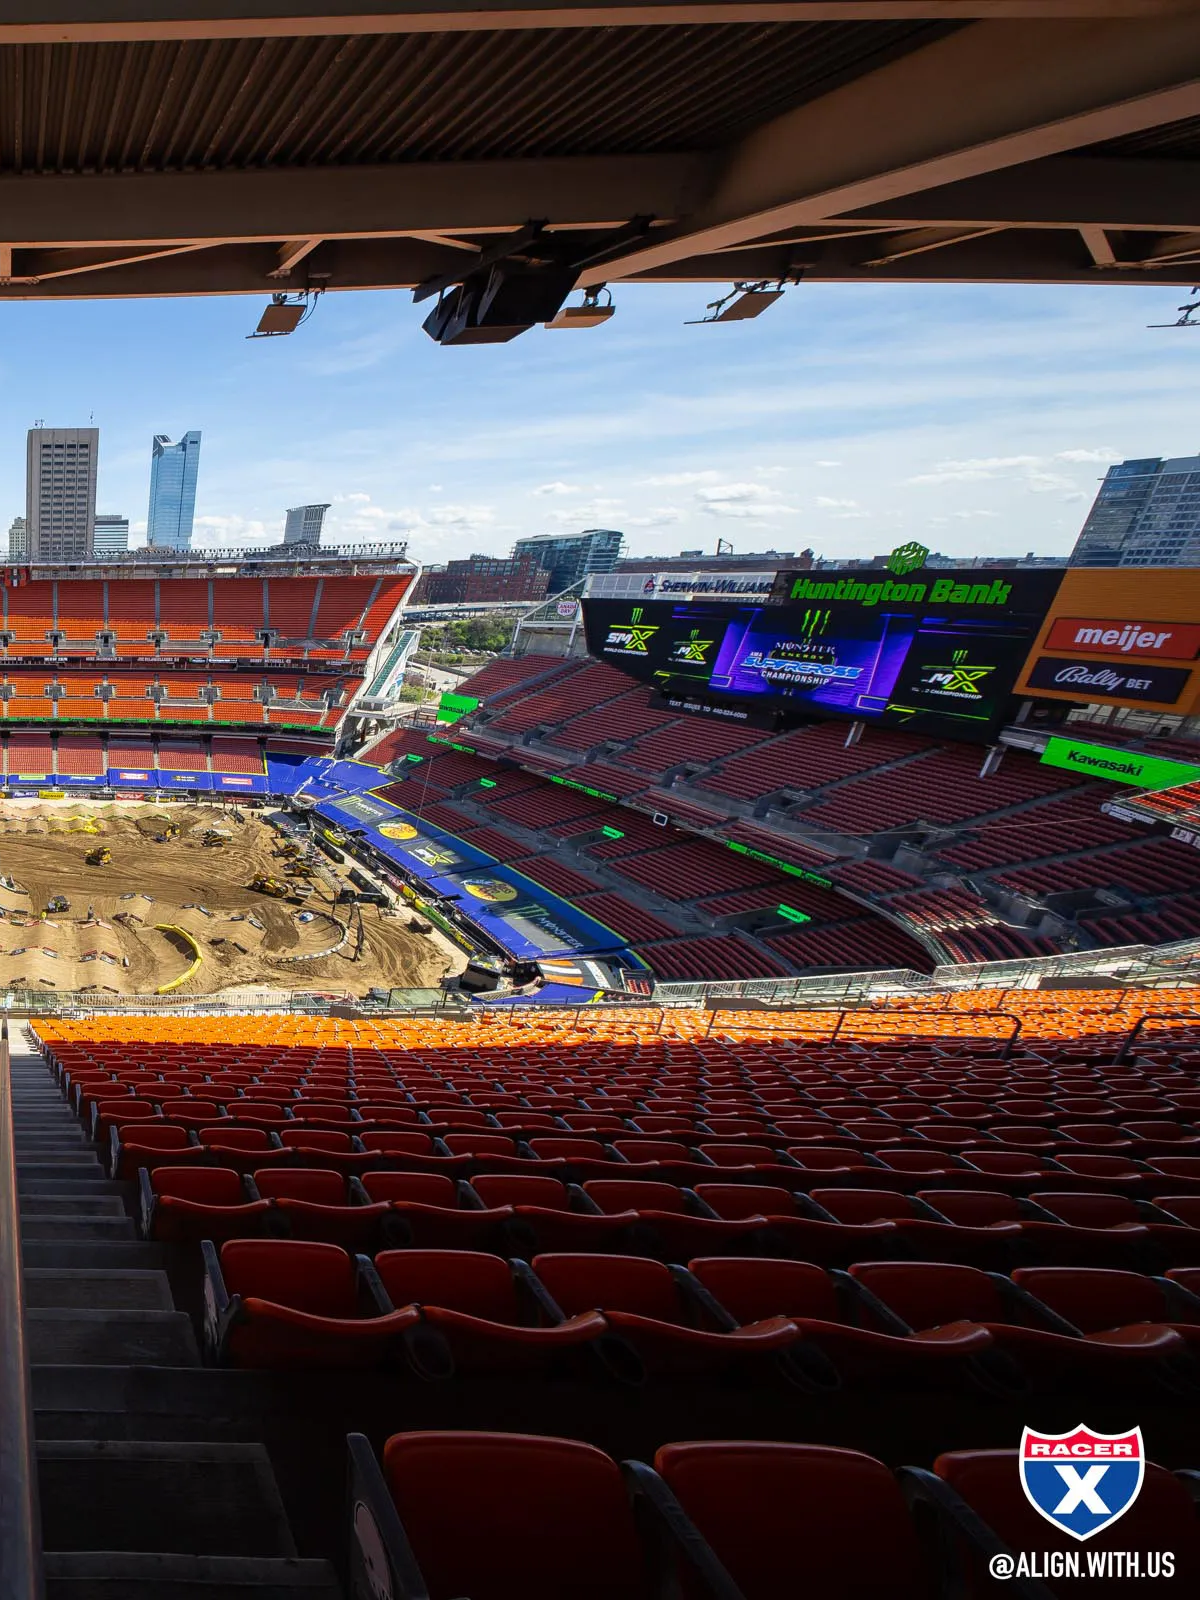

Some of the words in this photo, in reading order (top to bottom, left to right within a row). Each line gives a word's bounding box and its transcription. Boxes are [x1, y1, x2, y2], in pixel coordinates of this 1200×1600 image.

[790, 578, 927, 606] Huntington
[929, 579, 1013, 605] Bank
[606, 630, 656, 651] SMX
[1074, 624, 1173, 652] meijer
[761, 670, 831, 686] CHAMPIONSHIP
[1054, 666, 1125, 691] Bally
[1126, 678, 1153, 691] BET
[930, 689, 983, 700] CHAMPIONSHIP
[1067, 750, 1144, 777] Kawasaki
[538, 917, 584, 948] MONSTER
